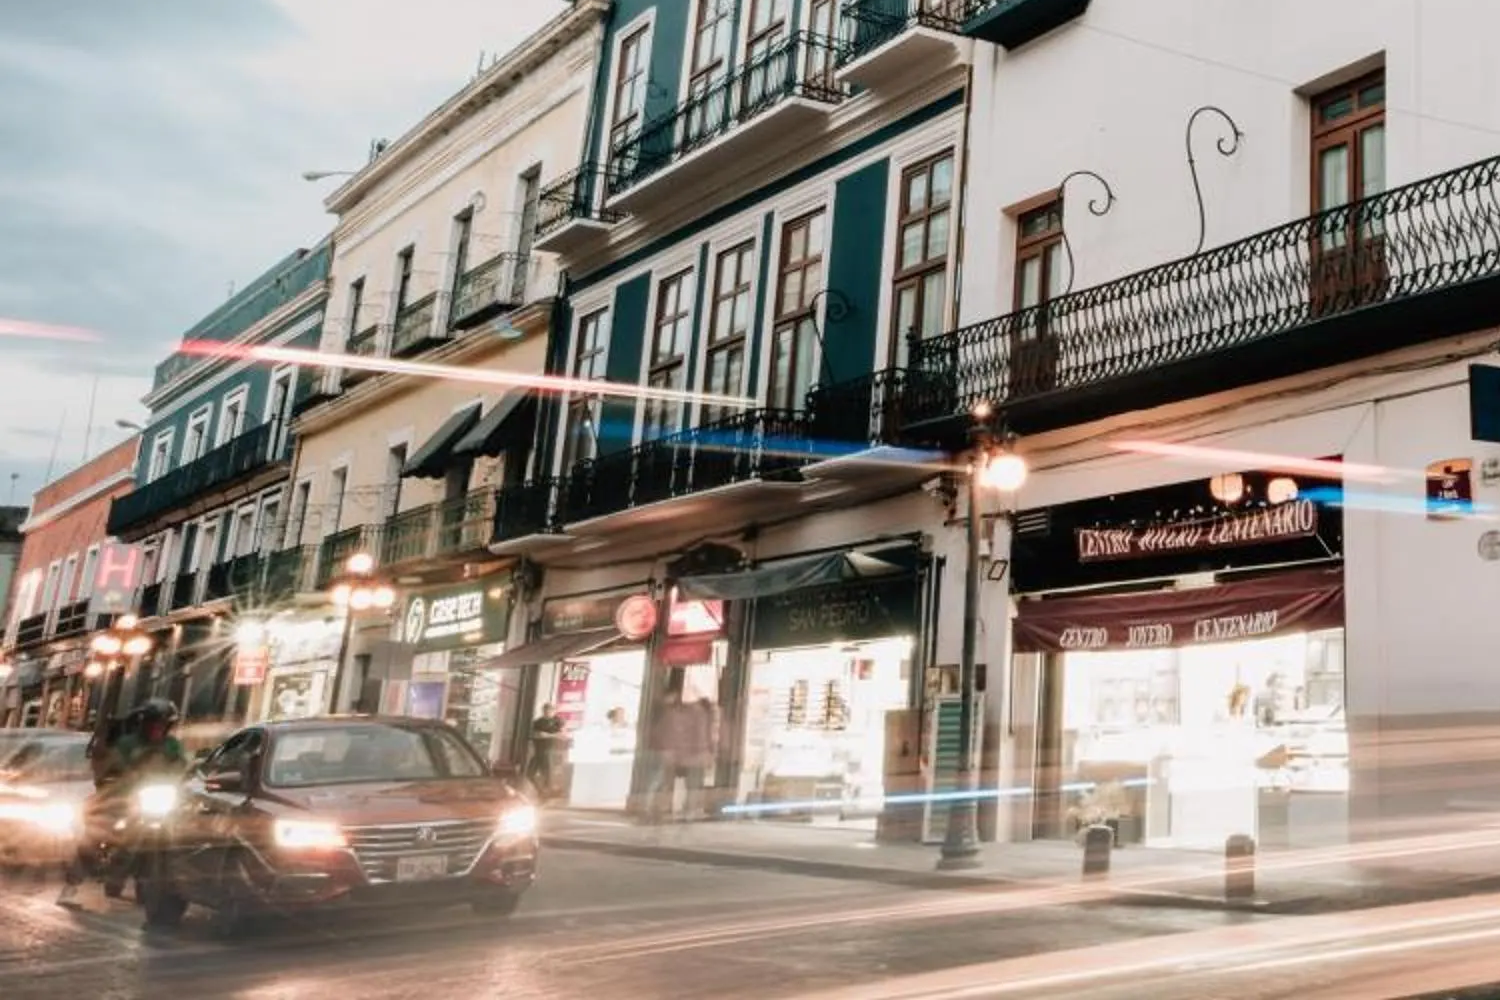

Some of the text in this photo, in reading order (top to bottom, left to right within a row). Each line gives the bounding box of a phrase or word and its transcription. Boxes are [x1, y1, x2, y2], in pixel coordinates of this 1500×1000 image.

[97, 546, 137, 590] H
[1059, 609, 1280, 649] CENTRO JOYERO CENTENARIO
